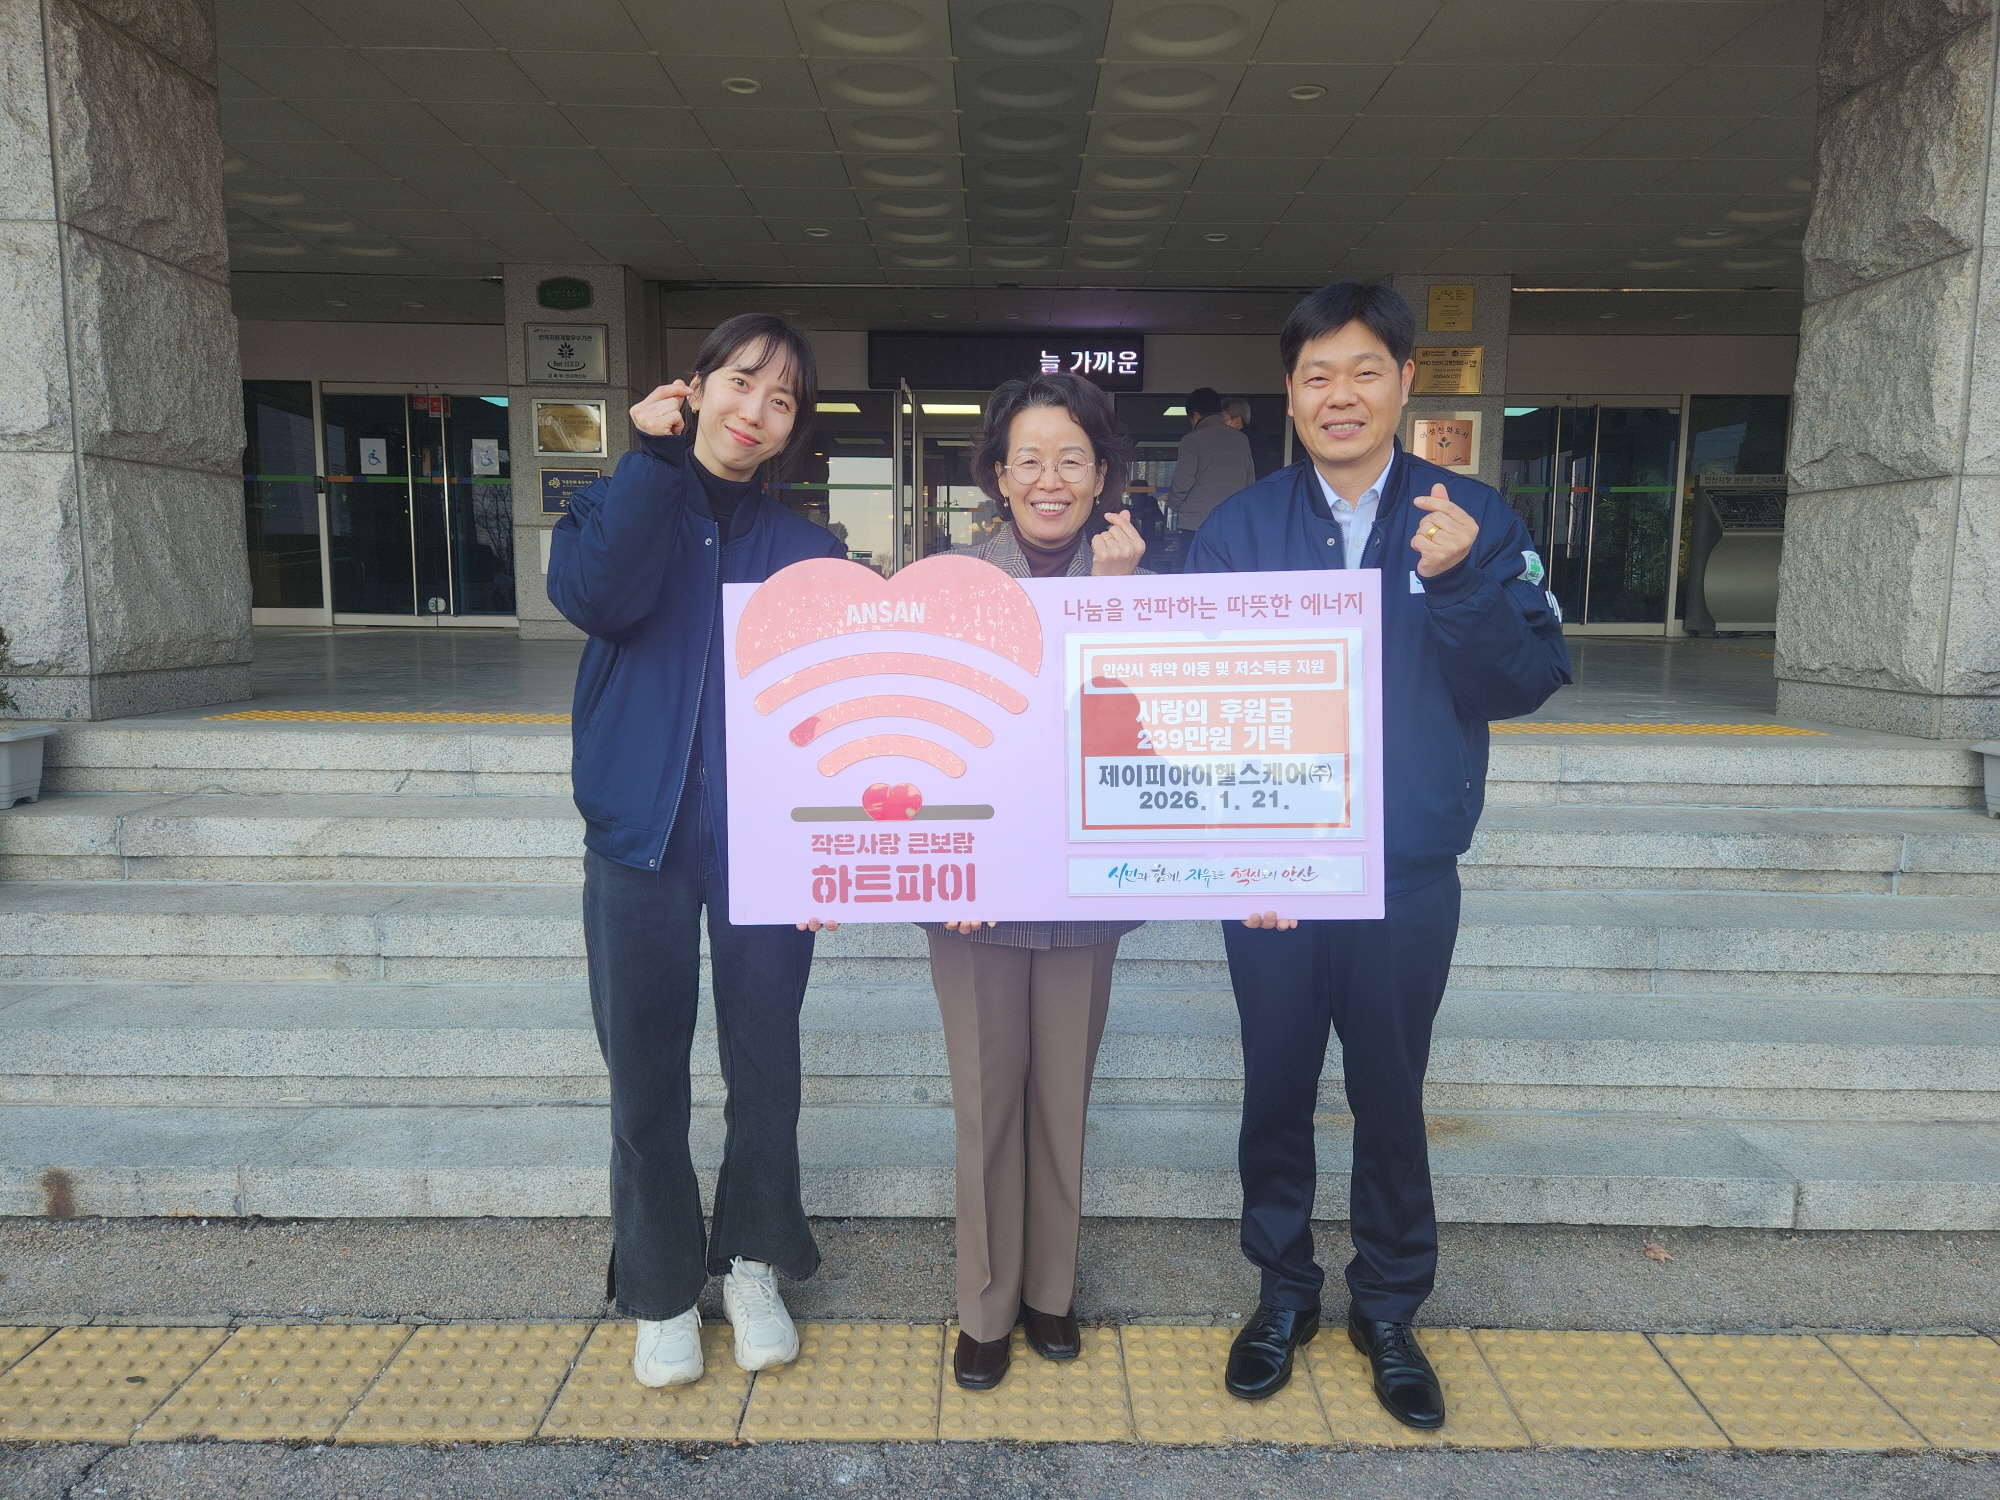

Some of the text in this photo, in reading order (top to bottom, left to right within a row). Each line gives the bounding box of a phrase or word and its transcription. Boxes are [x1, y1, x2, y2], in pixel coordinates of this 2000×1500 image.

[1040, 350, 1138, 375] 늘 가까운
[1704, 476, 1732, 484] 안산시청
[846, 600, 926, 627] ANSAN
[1064, 591, 1364, 622] 나눔을 전파하는 따뜻한 에너지
[1102, 658, 1325, 678] 안산시 취약 아동 및 저소득층 지원
[1135, 697, 1293, 725] 사랑의 후원금
[1137, 725, 1293, 751] 239만원 기탁
[1139, 789, 1290, 811] 2026. 1. 21.
[811, 832, 975, 856] 작은사랑 큰보람
[811, 863, 976, 904] 하트파이
[1107, 862, 1150, 888] 시민과
[1281, 865, 1320, 883] 안산
